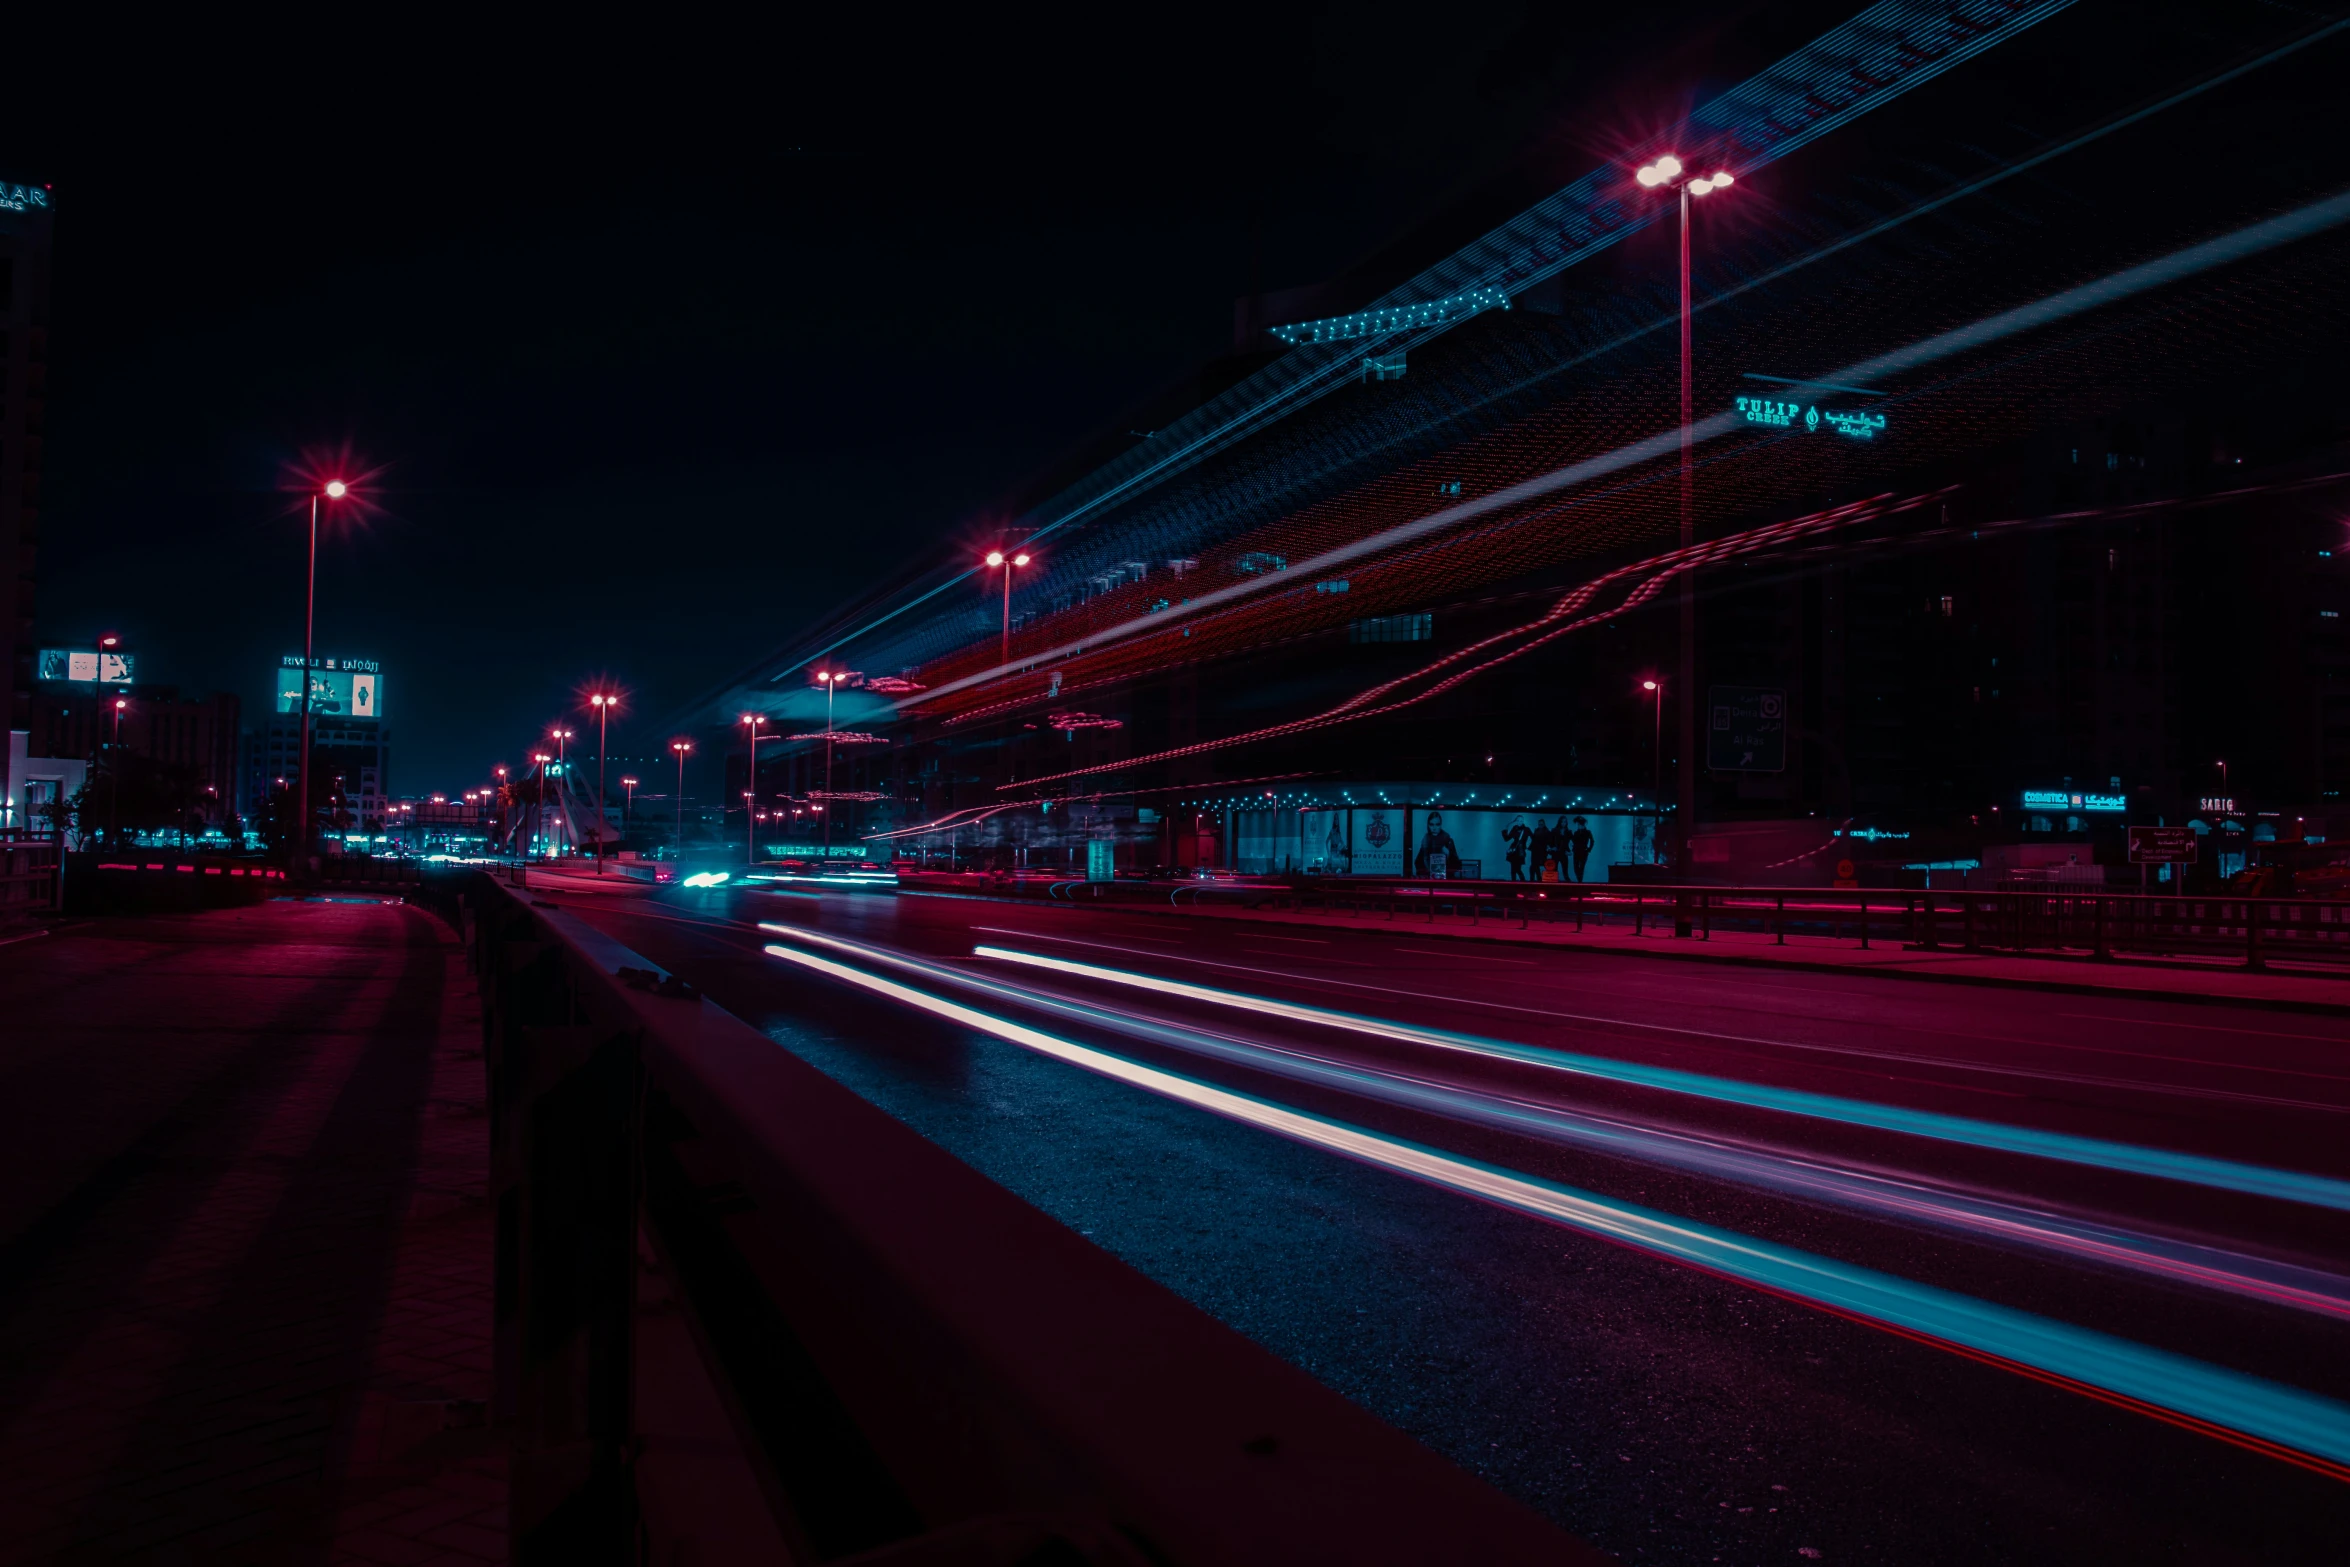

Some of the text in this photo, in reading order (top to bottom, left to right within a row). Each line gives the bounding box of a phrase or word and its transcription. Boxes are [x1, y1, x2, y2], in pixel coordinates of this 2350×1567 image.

[1737, 398, 1800, 418] TULIP
[1746, 411, 1790, 426] CREEK
[1732, 706, 1758, 718] Deira
[1733, 734, 1765, 747] Al Ras
[2025, 791, 2069, 804] COSMETICA
